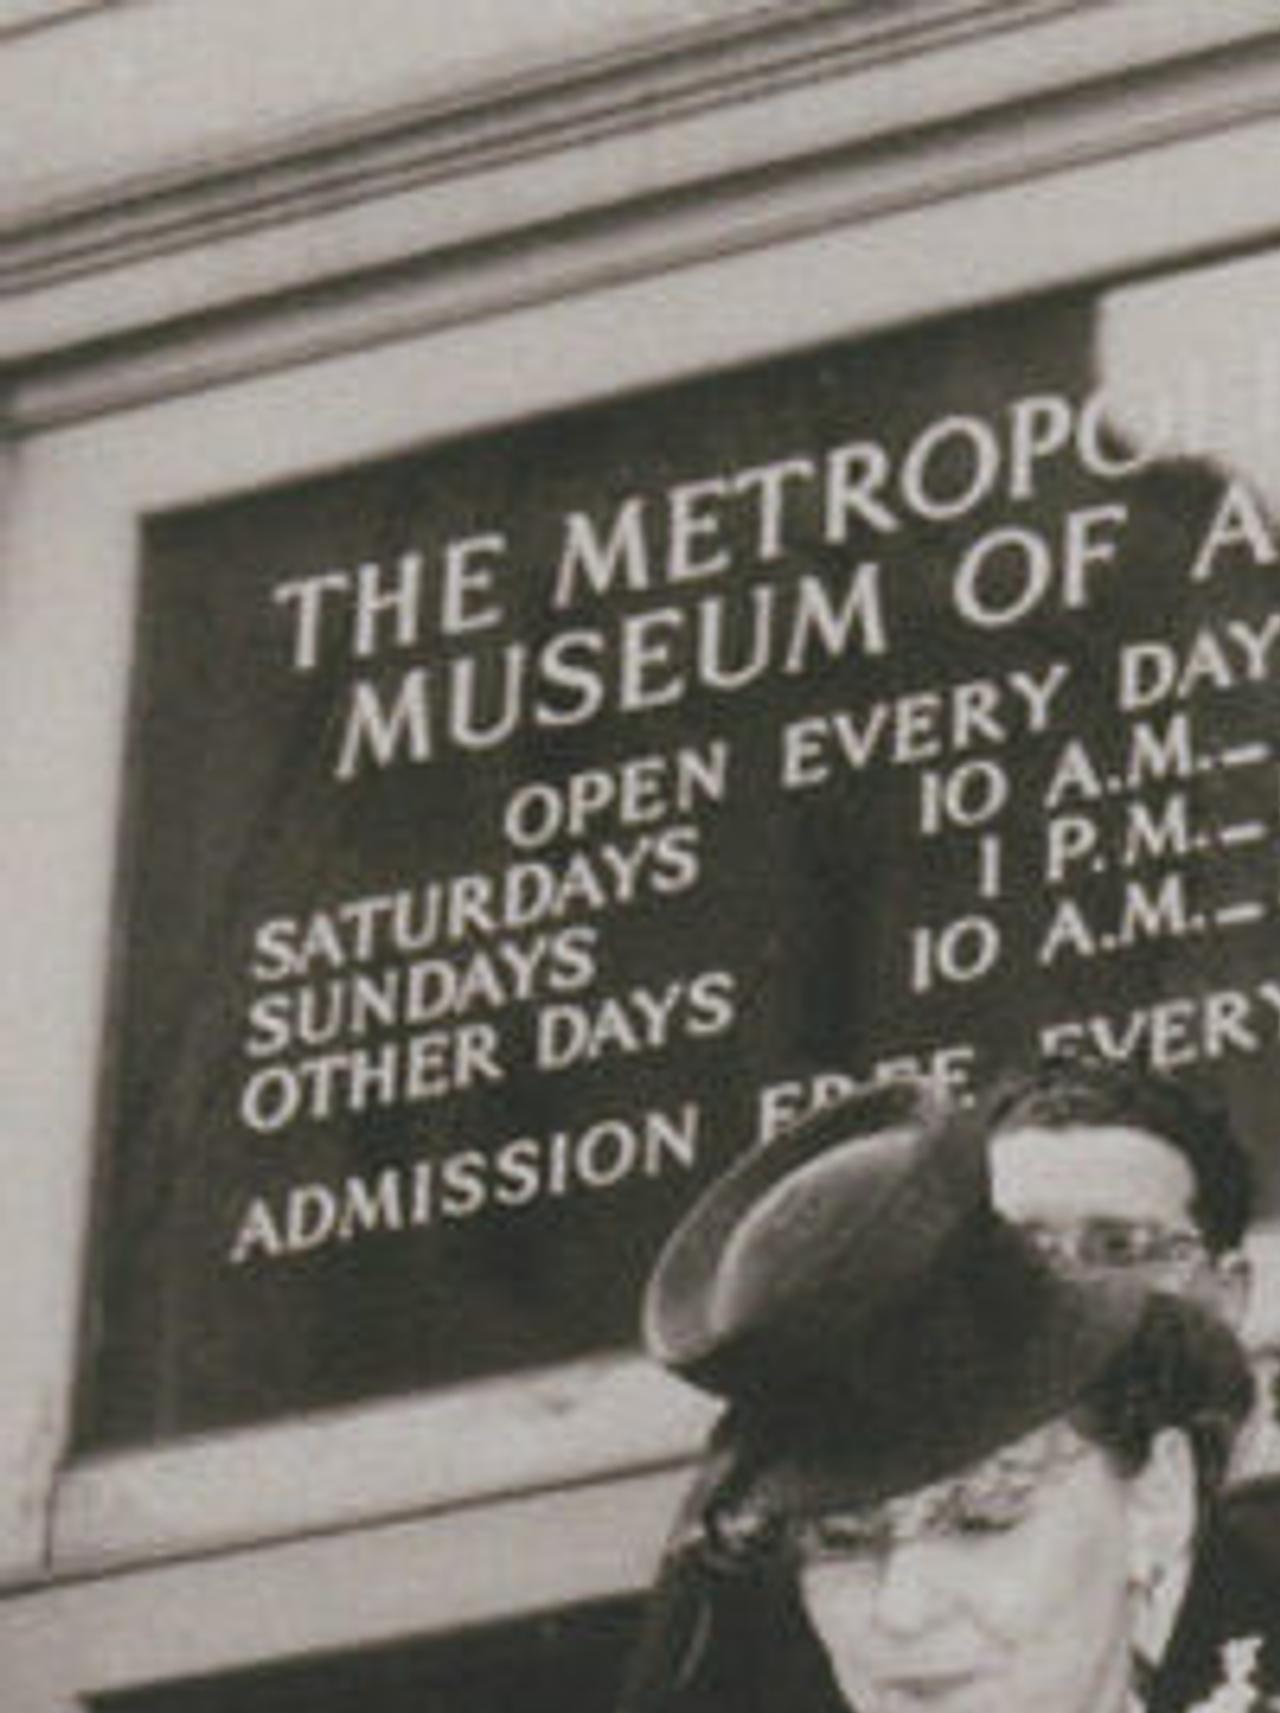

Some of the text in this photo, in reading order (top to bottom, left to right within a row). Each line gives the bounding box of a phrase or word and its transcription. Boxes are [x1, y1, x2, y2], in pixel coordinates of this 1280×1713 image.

[274, 534, 506, 668] THE
[334, 562, 886, 782] MUSEUM
[953, 503, 1128, 627] OF
[503, 742, 728, 850] OPEN
[780, 663, 1068, 788] EVERY
[250, 826, 702, 982] SATURDAYS
[918, 759, 1008, 834] 10
[238, 1027, 503, 1133] OTHER
[537, 972, 737, 1070] DAYS
[911, 916, 999, 994] 10
[244, 926, 600, 1059] SUNDAYS
[228, 1104, 700, 1264] ADMISSION
